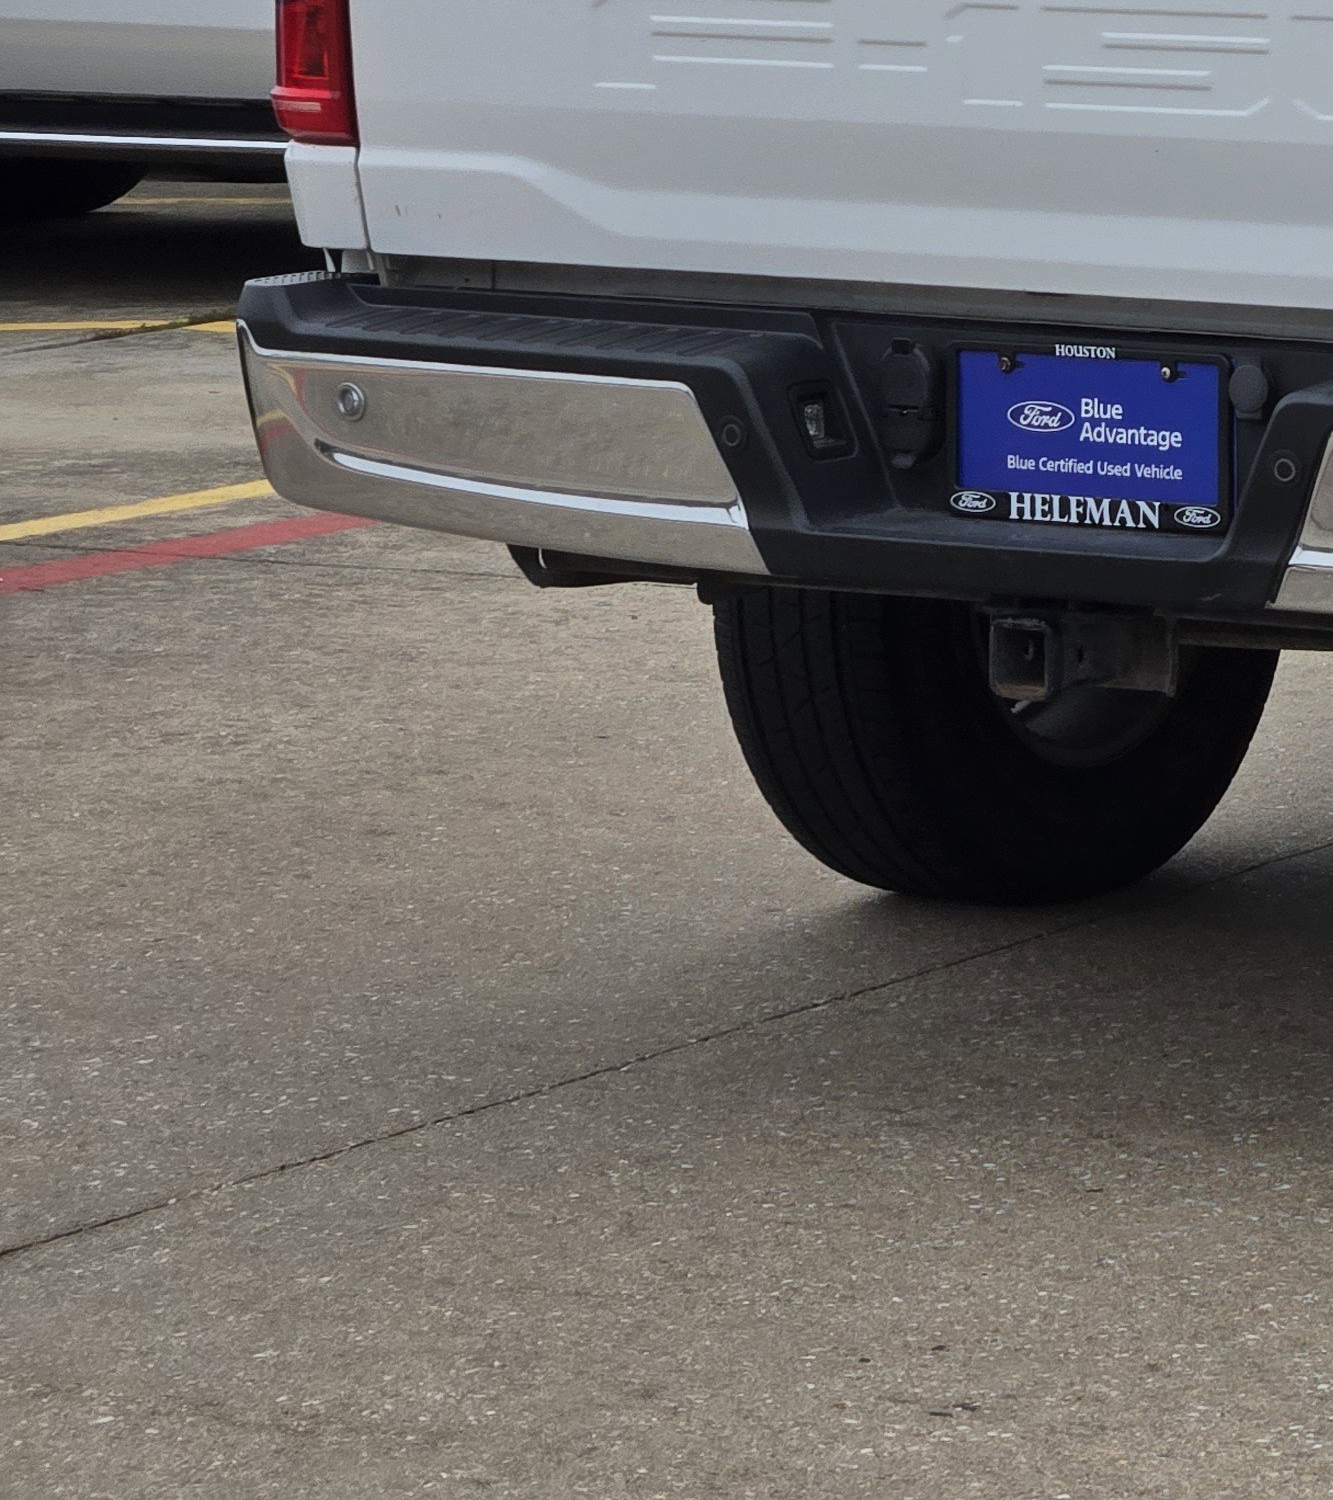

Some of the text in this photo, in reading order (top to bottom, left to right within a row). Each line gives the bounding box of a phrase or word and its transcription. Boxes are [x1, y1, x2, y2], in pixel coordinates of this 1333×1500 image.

[1055, 344, 1116, 359] HOUSTON
[1019, 404, 1061, 429] Ford
[1081, 398, 1123, 420] Blue
[1079, 422, 1182, 451] Advantage
[1007, 454, 1183, 480] Blue Certified Used Vehicle
[958, 493, 987, 510] Ford
[1008, 491, 1161, 529] HELFMAN
[1182, 508, 1212, 525] Ford
